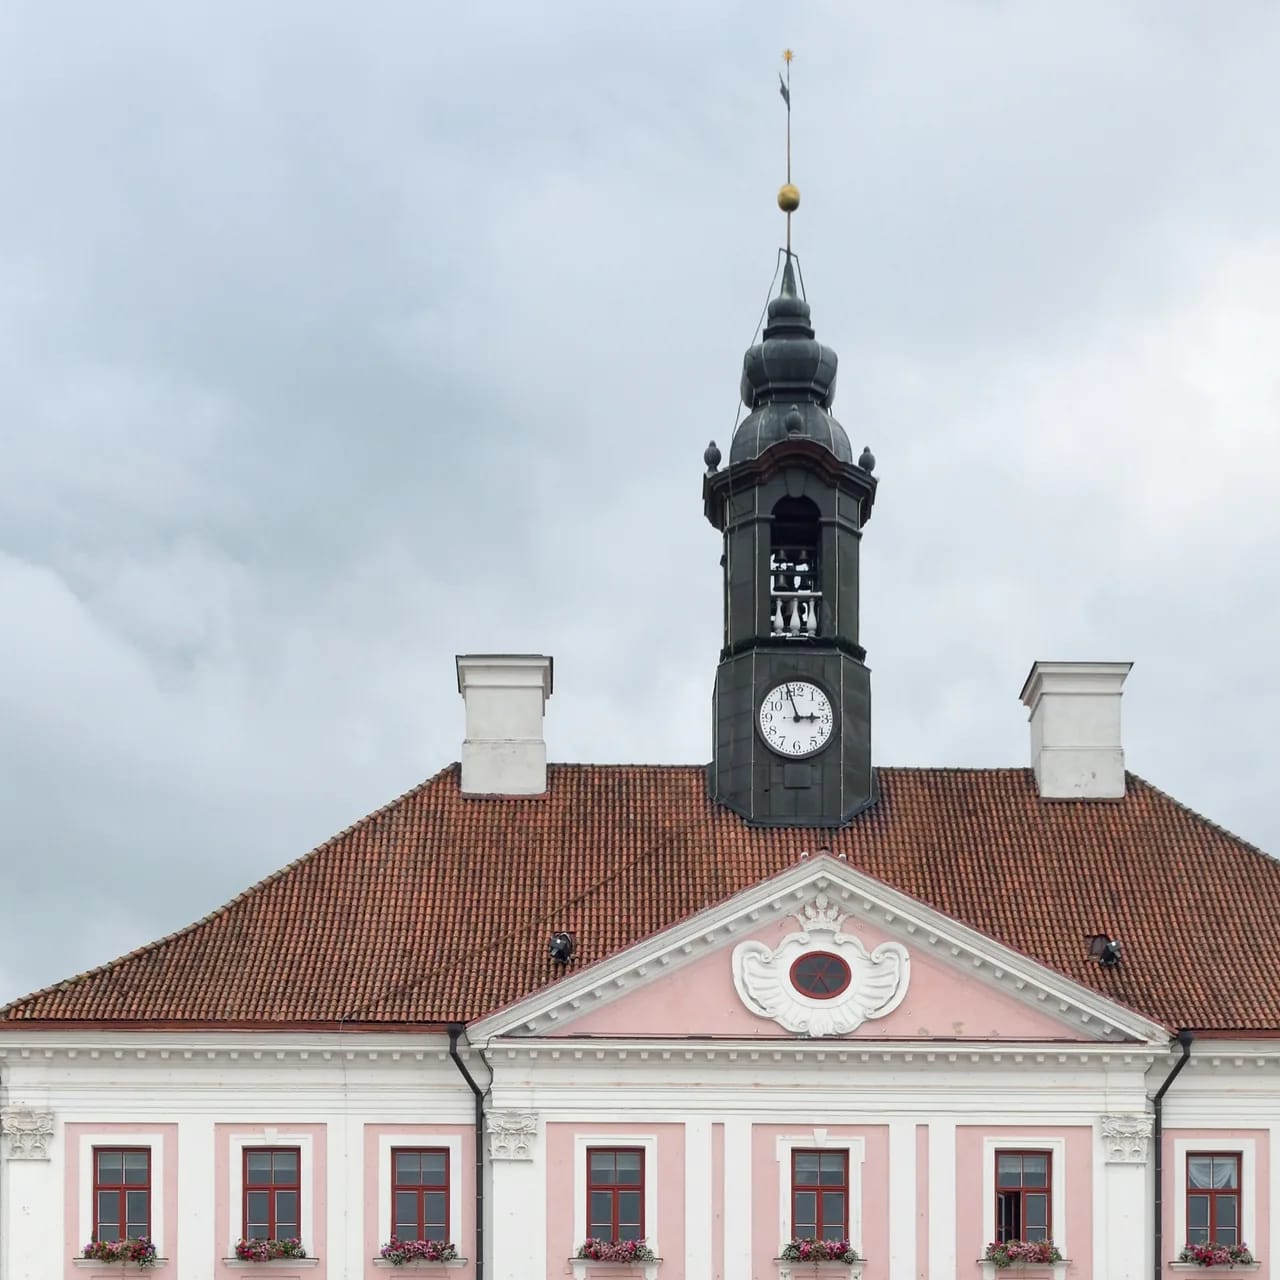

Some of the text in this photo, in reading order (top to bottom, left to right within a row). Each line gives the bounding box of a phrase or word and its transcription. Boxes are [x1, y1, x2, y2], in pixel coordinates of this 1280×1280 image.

[809, 690, 816, 701] 1
[768, 701, 783, 711] 10
[818, 701, 825, 711] 2
[765, 712, 773, 722] 9
[821, 714, 829, 724] 3
[768, 725, 777, 735] 8
[817, 726, 825, 736] 4
[778, 735, 786, 747] 7
[792, 740, 801, 751] 6
[809, 736, 818, 748] 5
